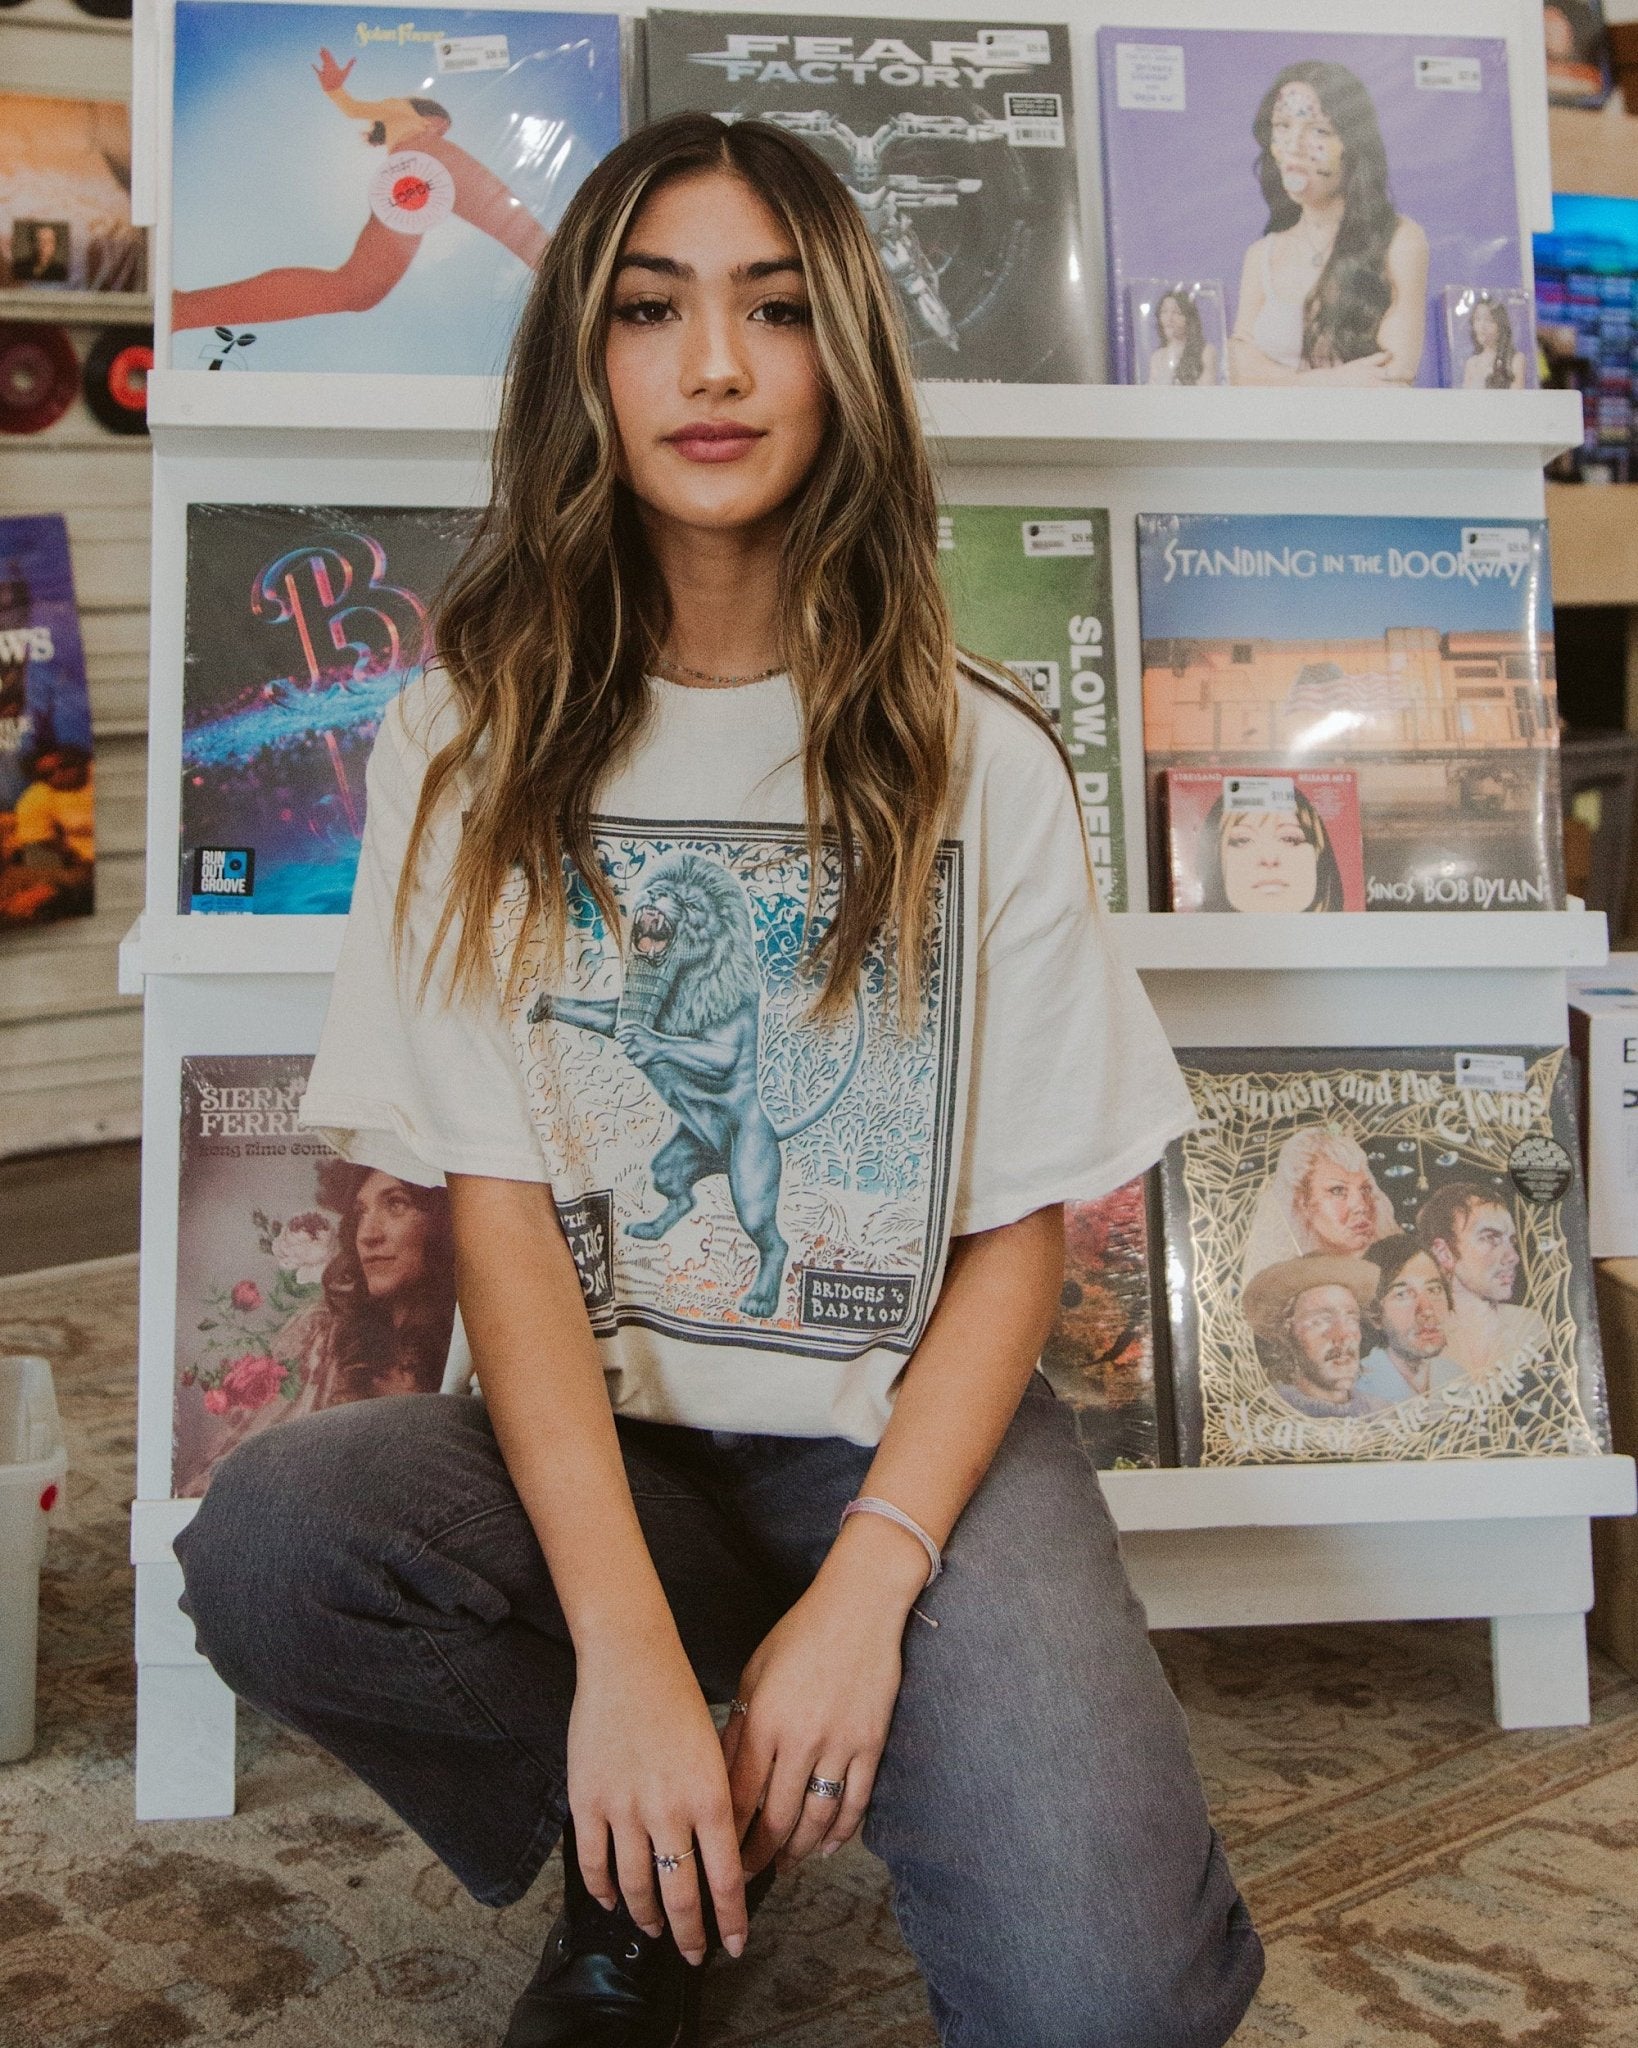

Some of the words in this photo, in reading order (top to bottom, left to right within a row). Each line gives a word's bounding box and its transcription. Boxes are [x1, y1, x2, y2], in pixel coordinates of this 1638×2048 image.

[726, 34, 988, 66] FEAR
[724, 60, 1001, 89] FACTORY
[1163, 537, 1318, 584] STANDING
[1323, 553, 1345, 574] IN
[1350, 553, 1384, 575] THE
[1069, 614, 1108, 757] SLOW,
[202, 850, 226, 865] RUN
[201, 864, 225, 879] OUT
[201, 877, 247, 894] GROOVE
[1367, 875, 1417, 904] SINGS
[1423, 876, 1470, 904] BOB
[1473, 874, 1545, 910] DYLAN
[200, 1086, 300, 1112] SIERR
[1199, 1078, 1335, 1130] hannon
[1339, 1068, 1396, 1107] and
[1400, 1069, 1444, 1105] the
[200, 1111, 314, 1137] FERRE
[812, 1279, 886, 1304] BRIDGES
[890, 1287, 905, 1305] TO
[810, 1296, 904, 1323] BABYLON
